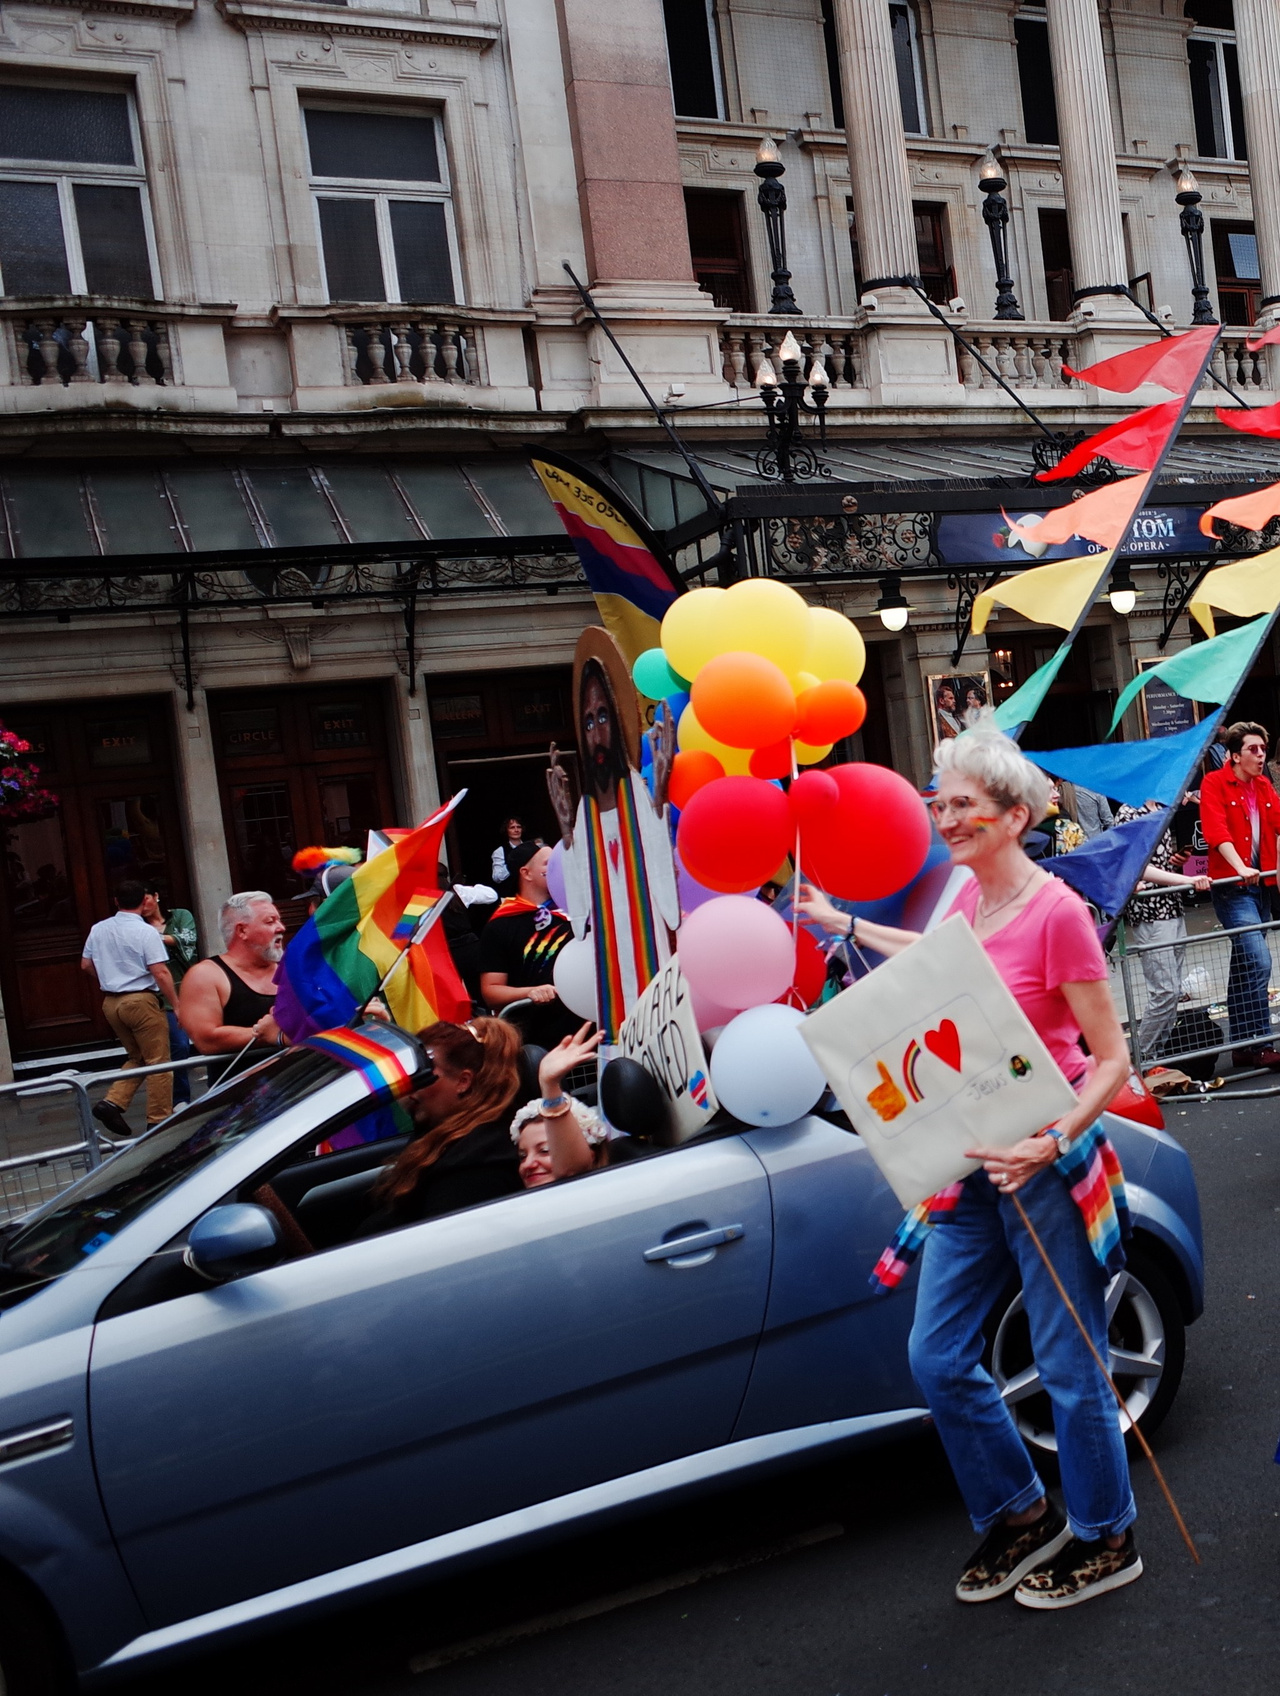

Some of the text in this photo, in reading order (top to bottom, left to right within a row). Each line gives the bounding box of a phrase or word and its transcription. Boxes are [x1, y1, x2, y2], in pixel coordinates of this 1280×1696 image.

[1129, 542, 1163, 552] OPERA
[323, 719, 353, 731] EXIT
[228, 729, 276, 744] CIRCLE
[650, 966, 685, 1036] ARE
[642, 1019, 689, 1102] OVED
